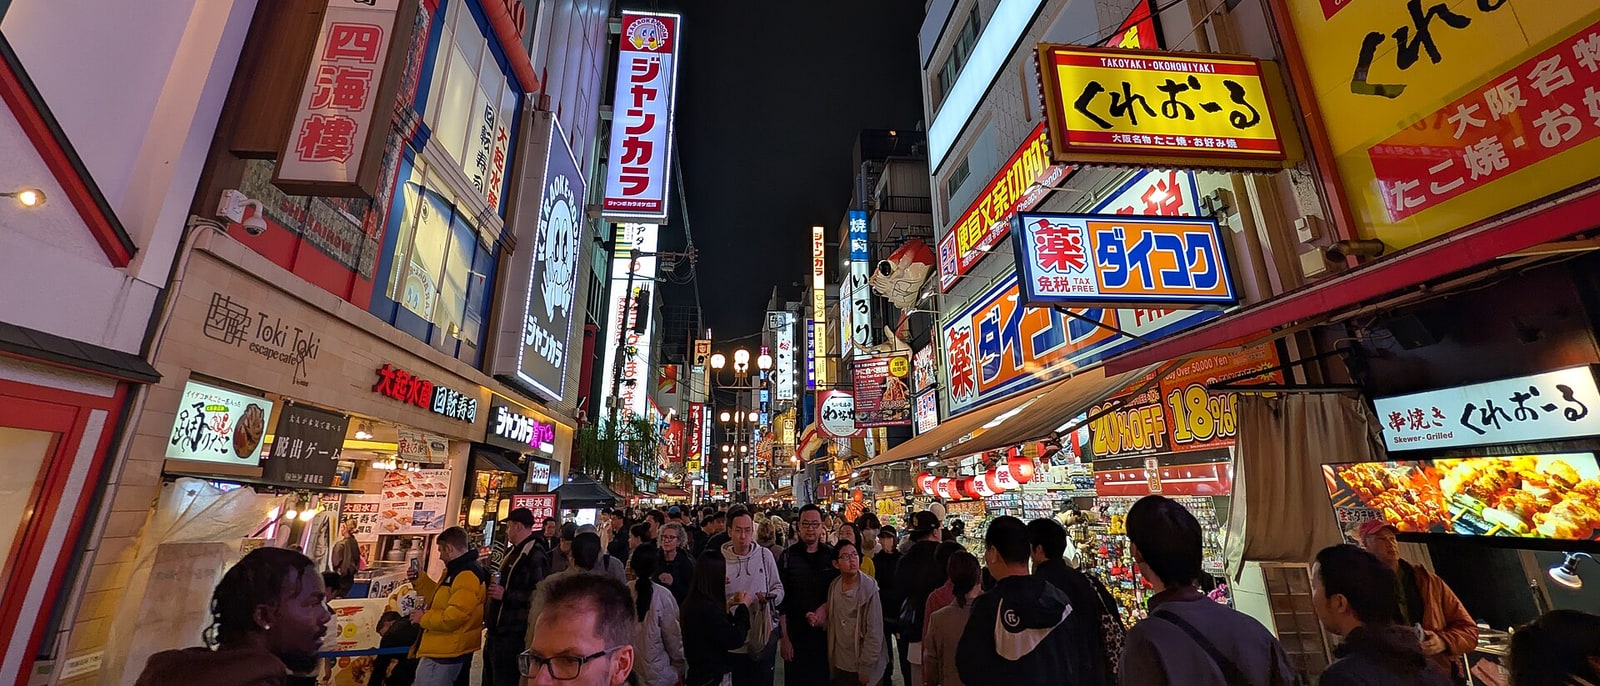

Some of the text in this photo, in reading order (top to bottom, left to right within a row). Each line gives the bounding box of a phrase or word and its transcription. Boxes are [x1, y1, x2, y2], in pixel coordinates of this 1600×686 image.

[1351, 0, 1504, 98] くれ
[296, 22, 384, 163] 四海樓
[1074, 75, 1261, 130] くれおーる
[619, 57, 661, 196] ジャンカラ
[814, 232, 823, 276] ジャンカラ
[850, 218, 867, 253] 焼肉
[1034, 221, 1088, 273] 薬
[1097, 227, 1219, 290] ダイコク
[1037, 276, 1071, 293] 免税
[1071, 285, 1095, 293] FREE
[1073, 278, 1091, 286] TAX
[852, 273, 870, 345] いろり
[249, 342, 298, 366] escape cafe
[256, 312, 321, 360] Toki Toki
[527, 314, 563, 369] ジャンカラ
[949, 326, 976, 401] 薬
[1176, 367, 1190, 377] Over
[1191, 358, 1213, 373] 50,000
[1213, 356, 1228, 366] Yen
[374, 364, 434, 409] 大起水産
[433, 386, 477, 424] 回転寿司
[496, 405, 534, 444] ジャンカラ
[1089, 401, 1165, 455] 20%OFF
[1388, 406, 1446, 432] 串焼き
[1460, 384, 1588, 435] くれおーる
[274, 436, 340, 460] 脱出ゲーム
[516, 498, 553, 507] 大起水産
